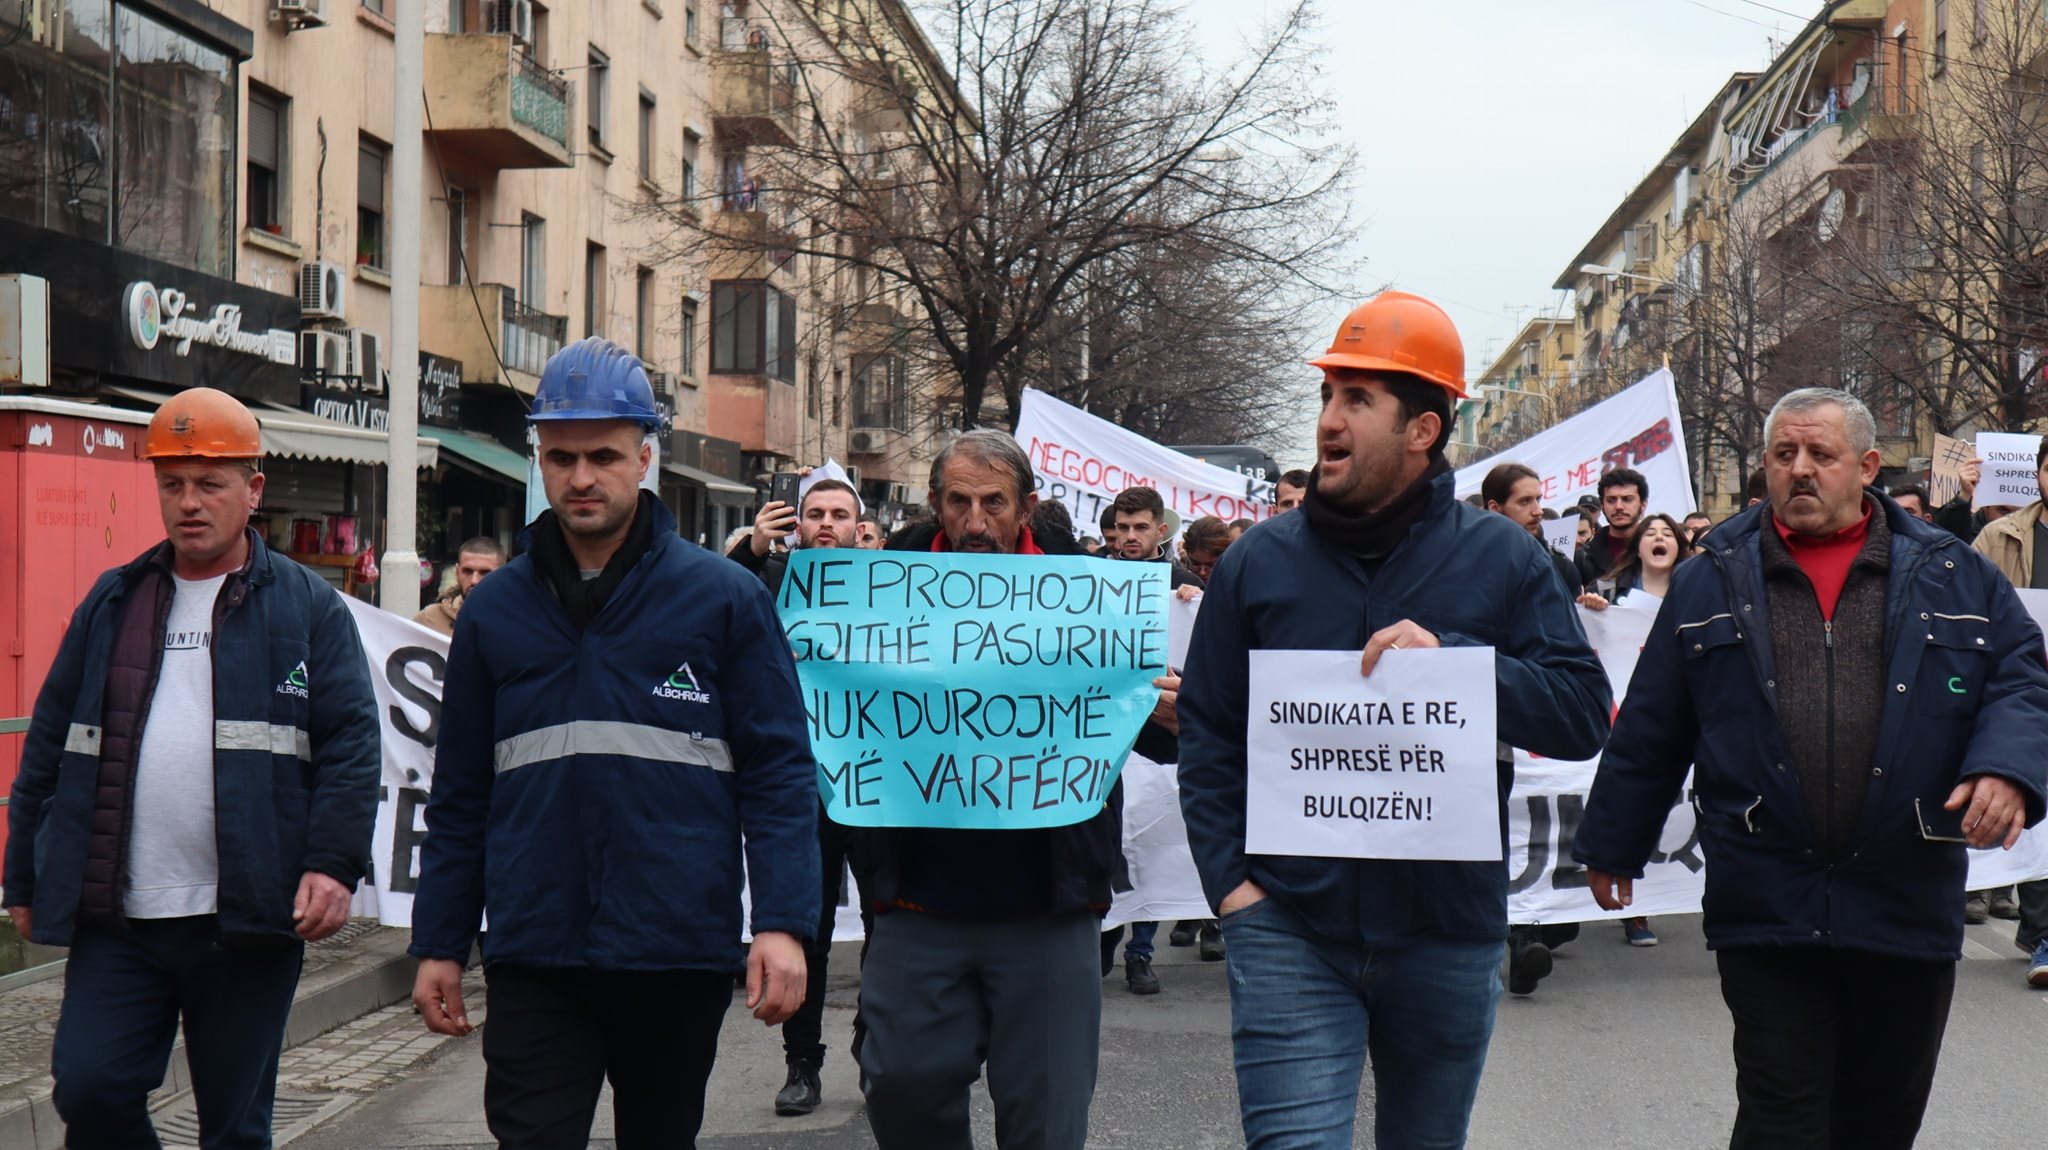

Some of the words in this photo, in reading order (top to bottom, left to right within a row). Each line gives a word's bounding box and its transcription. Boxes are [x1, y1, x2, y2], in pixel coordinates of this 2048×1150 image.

[314, 398, 355, 427] OPTIKA
[1567, 456, 1600, 492] ME
[784, 560, 853, 609] NE
[867, 559, 1164, 616] PRODHOJMË
[785, 614, 931, 665] GJITHË
[952, 619, 1168, 671] PASURINË
[652, 685, 710, 704] ALBCHROME
[892, 686, 1112, 742] DUROJMË
[1269, 701, 1394, 726] SINDIKATA
[1403, 702, 1416, 725] E
[1425, 701, 1467, 729] RE,
[1290, 744, 1393, 772] SHPRESË
[1401, 744, 1446, 773] PËR
[819, 748, 884, 809] MË
[1303, 791, 1432, 822] BULQIZËN!
